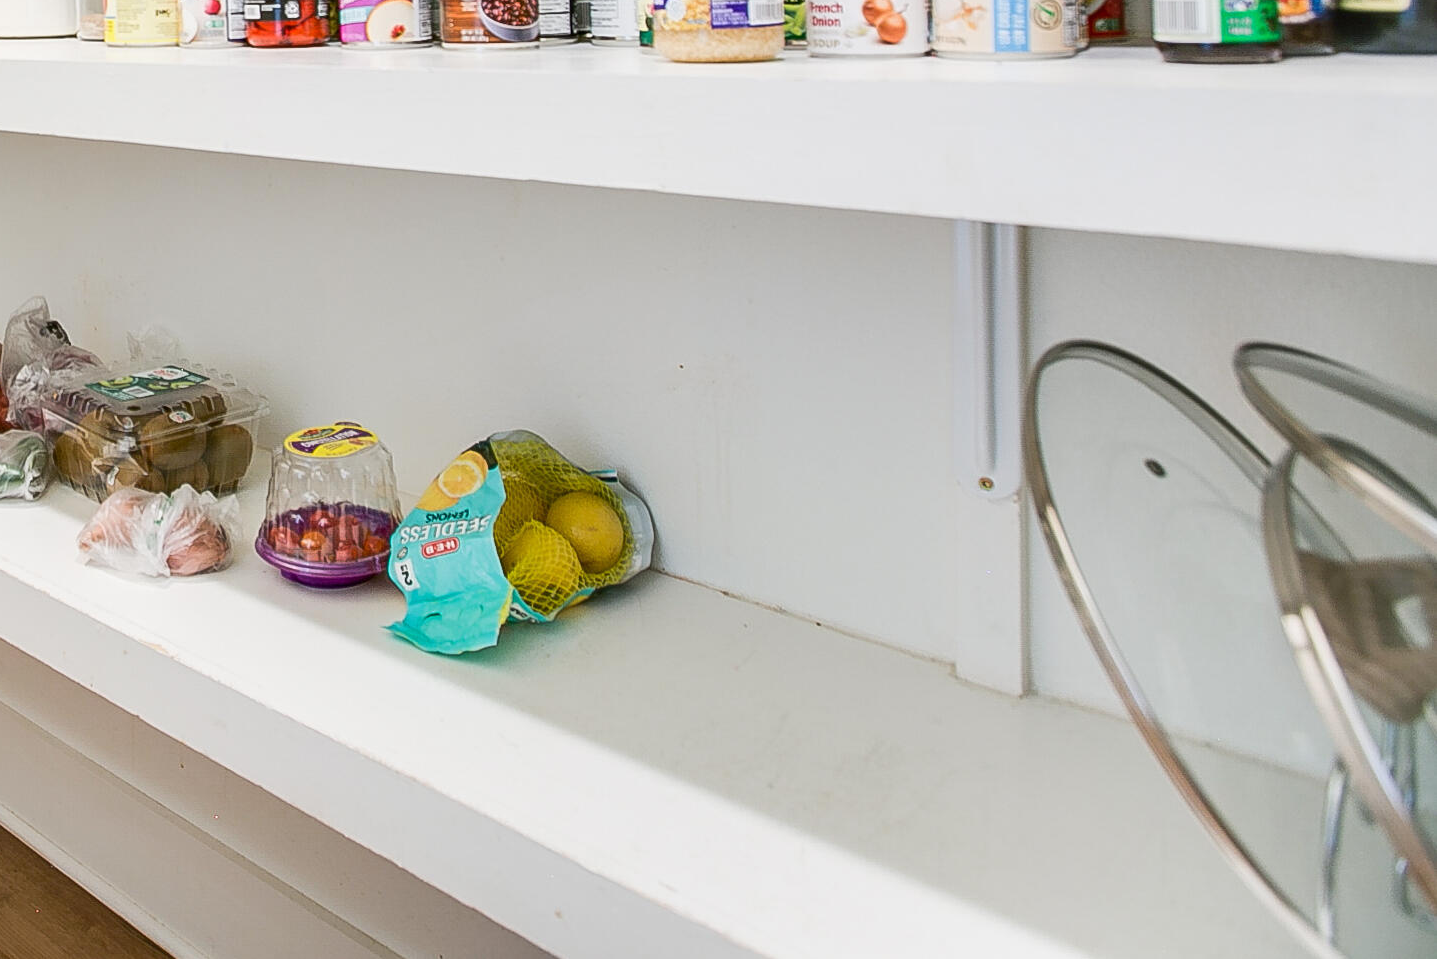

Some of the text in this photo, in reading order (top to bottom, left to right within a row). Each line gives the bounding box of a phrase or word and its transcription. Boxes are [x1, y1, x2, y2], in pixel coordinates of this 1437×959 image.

[810, 2, 843, 14] French
[812, 16, 841, 28] Onion
[425, 508, 470, 523] LEMONS
[400, 514, 492, 544] SEEDLESS
[425, 540, 455, 555] H-E-B
[402, 570, 413, 585] 2
